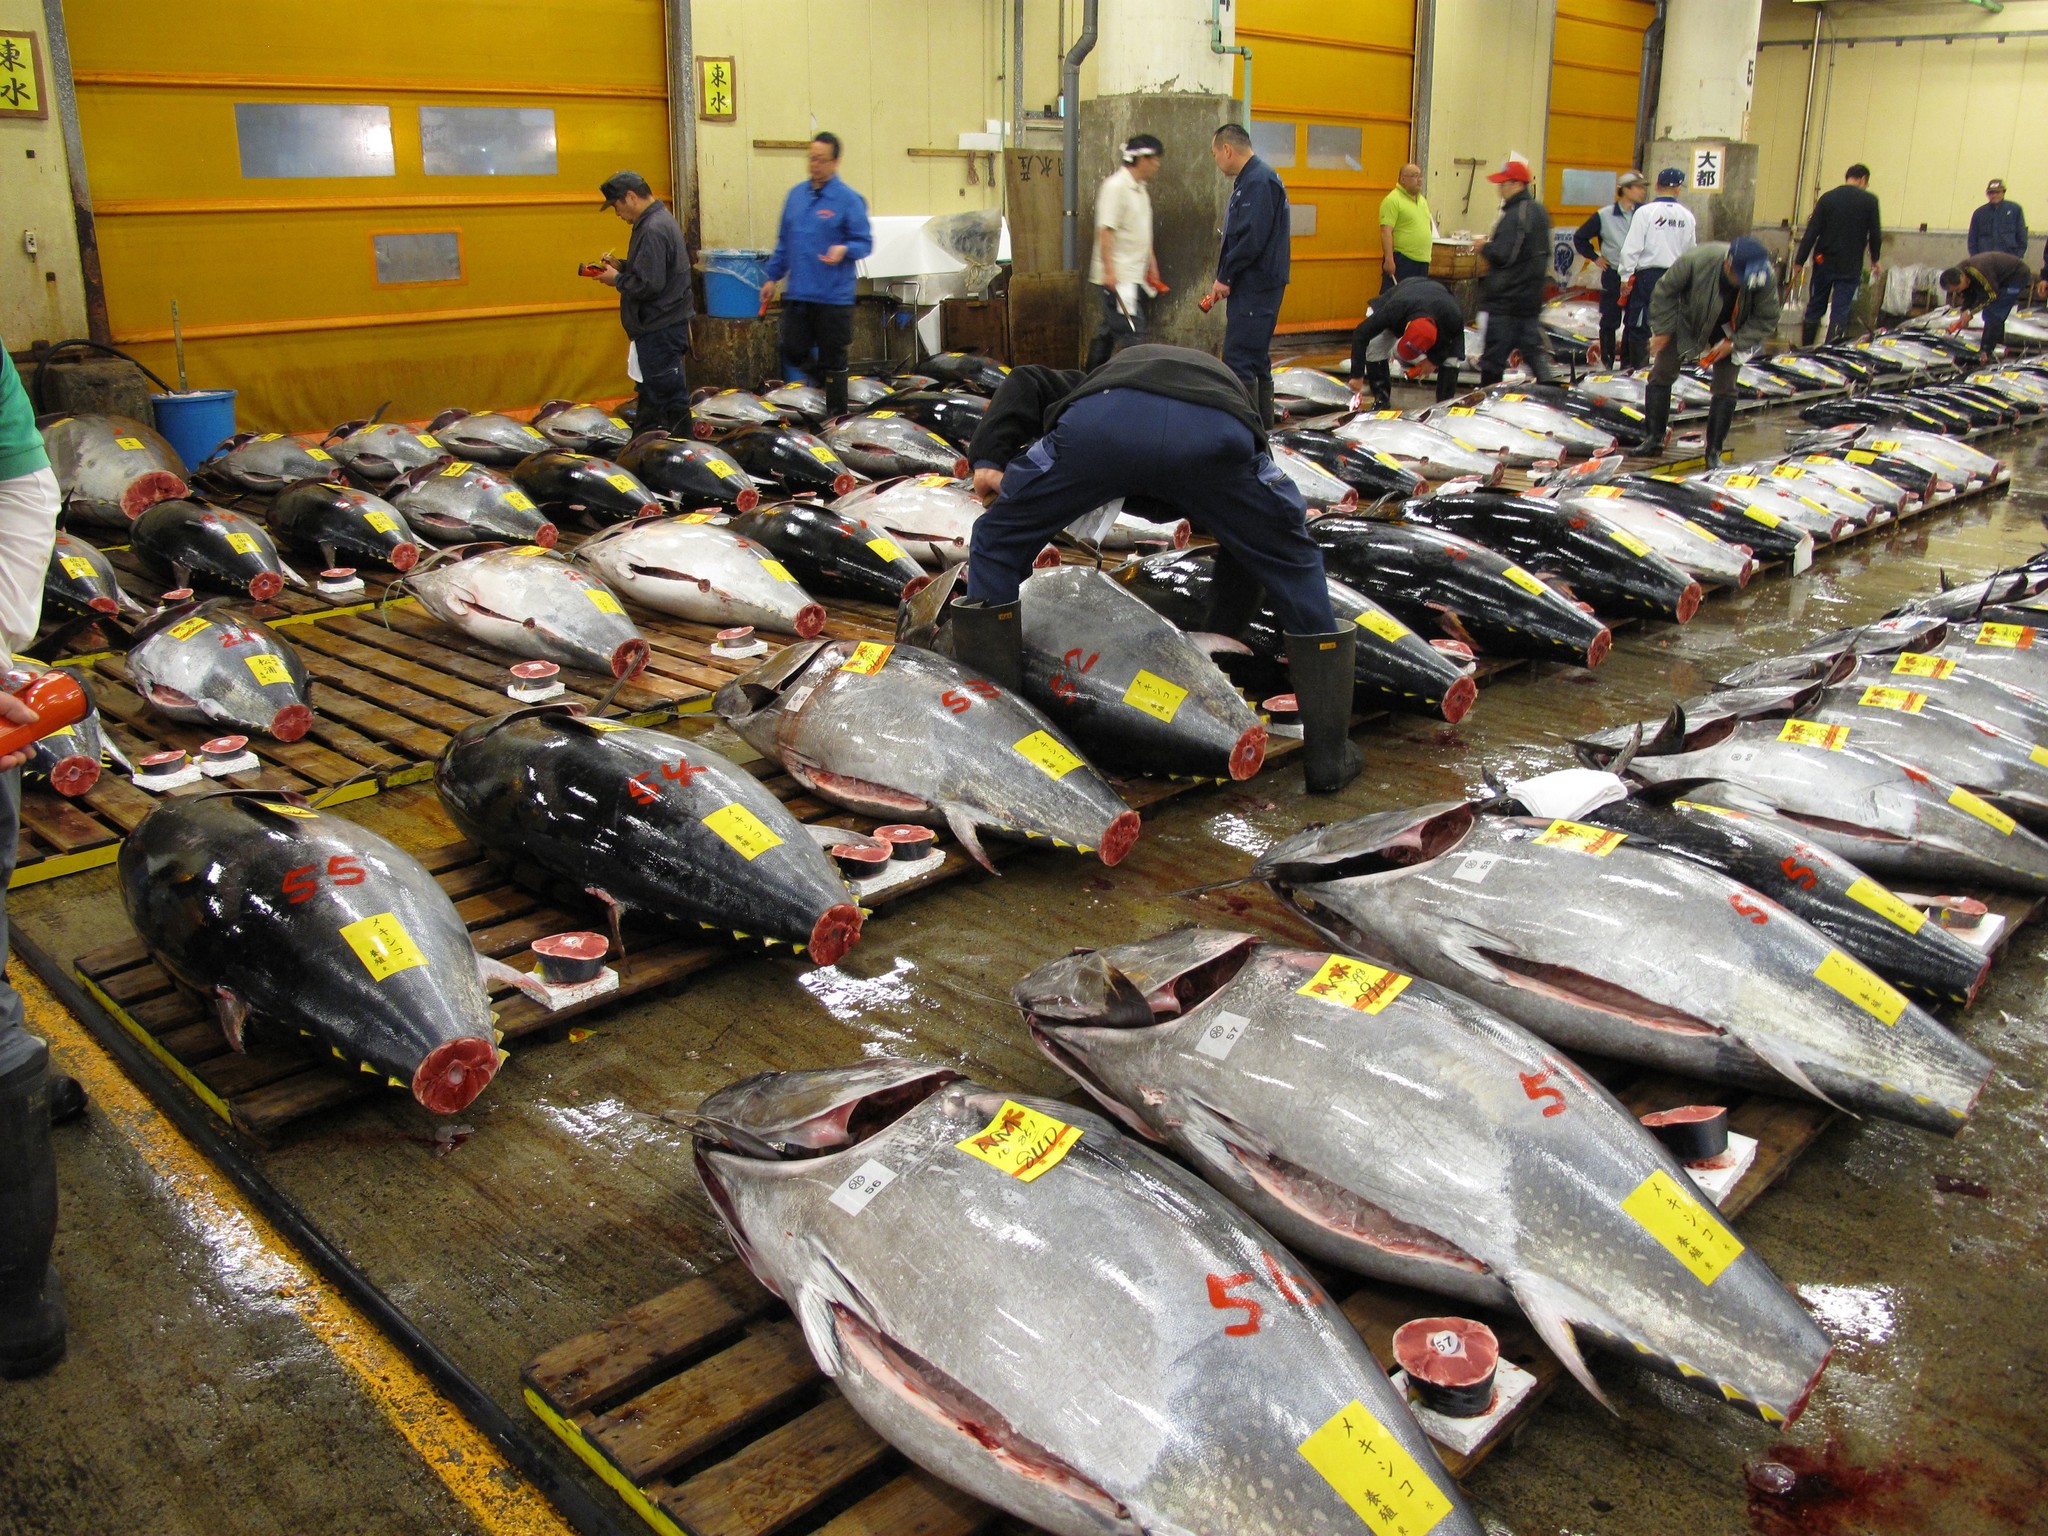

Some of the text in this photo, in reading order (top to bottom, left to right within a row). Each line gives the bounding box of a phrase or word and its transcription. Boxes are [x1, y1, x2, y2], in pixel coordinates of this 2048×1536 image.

[711, 63, 727, 113] 東水
[1697, 151, 1717, 187] 大都
[1034, 735, 1065, 761] メキシコ
[628, 759, 709, 805] 54
[728, 808, 762, 838] メキシコ
[282, 855, 366, 904] 55
[373, 918, 404, 955] メキシコ
[1831, 956, 1886, 995] メキシコ
[1226, 1027, 1238, 1040] 57
[864, 1180, 882, 1195] 56
[1653, 1182, 1713, 1241] メキシコ
[1676, 1235, 1704, 1261] 養殖
[1436, 1336, 1452, 1352] 57
[1343, 1417, 1414, 1497] メキシコ
[1364, 1489, 1398, 1525] 養殖
